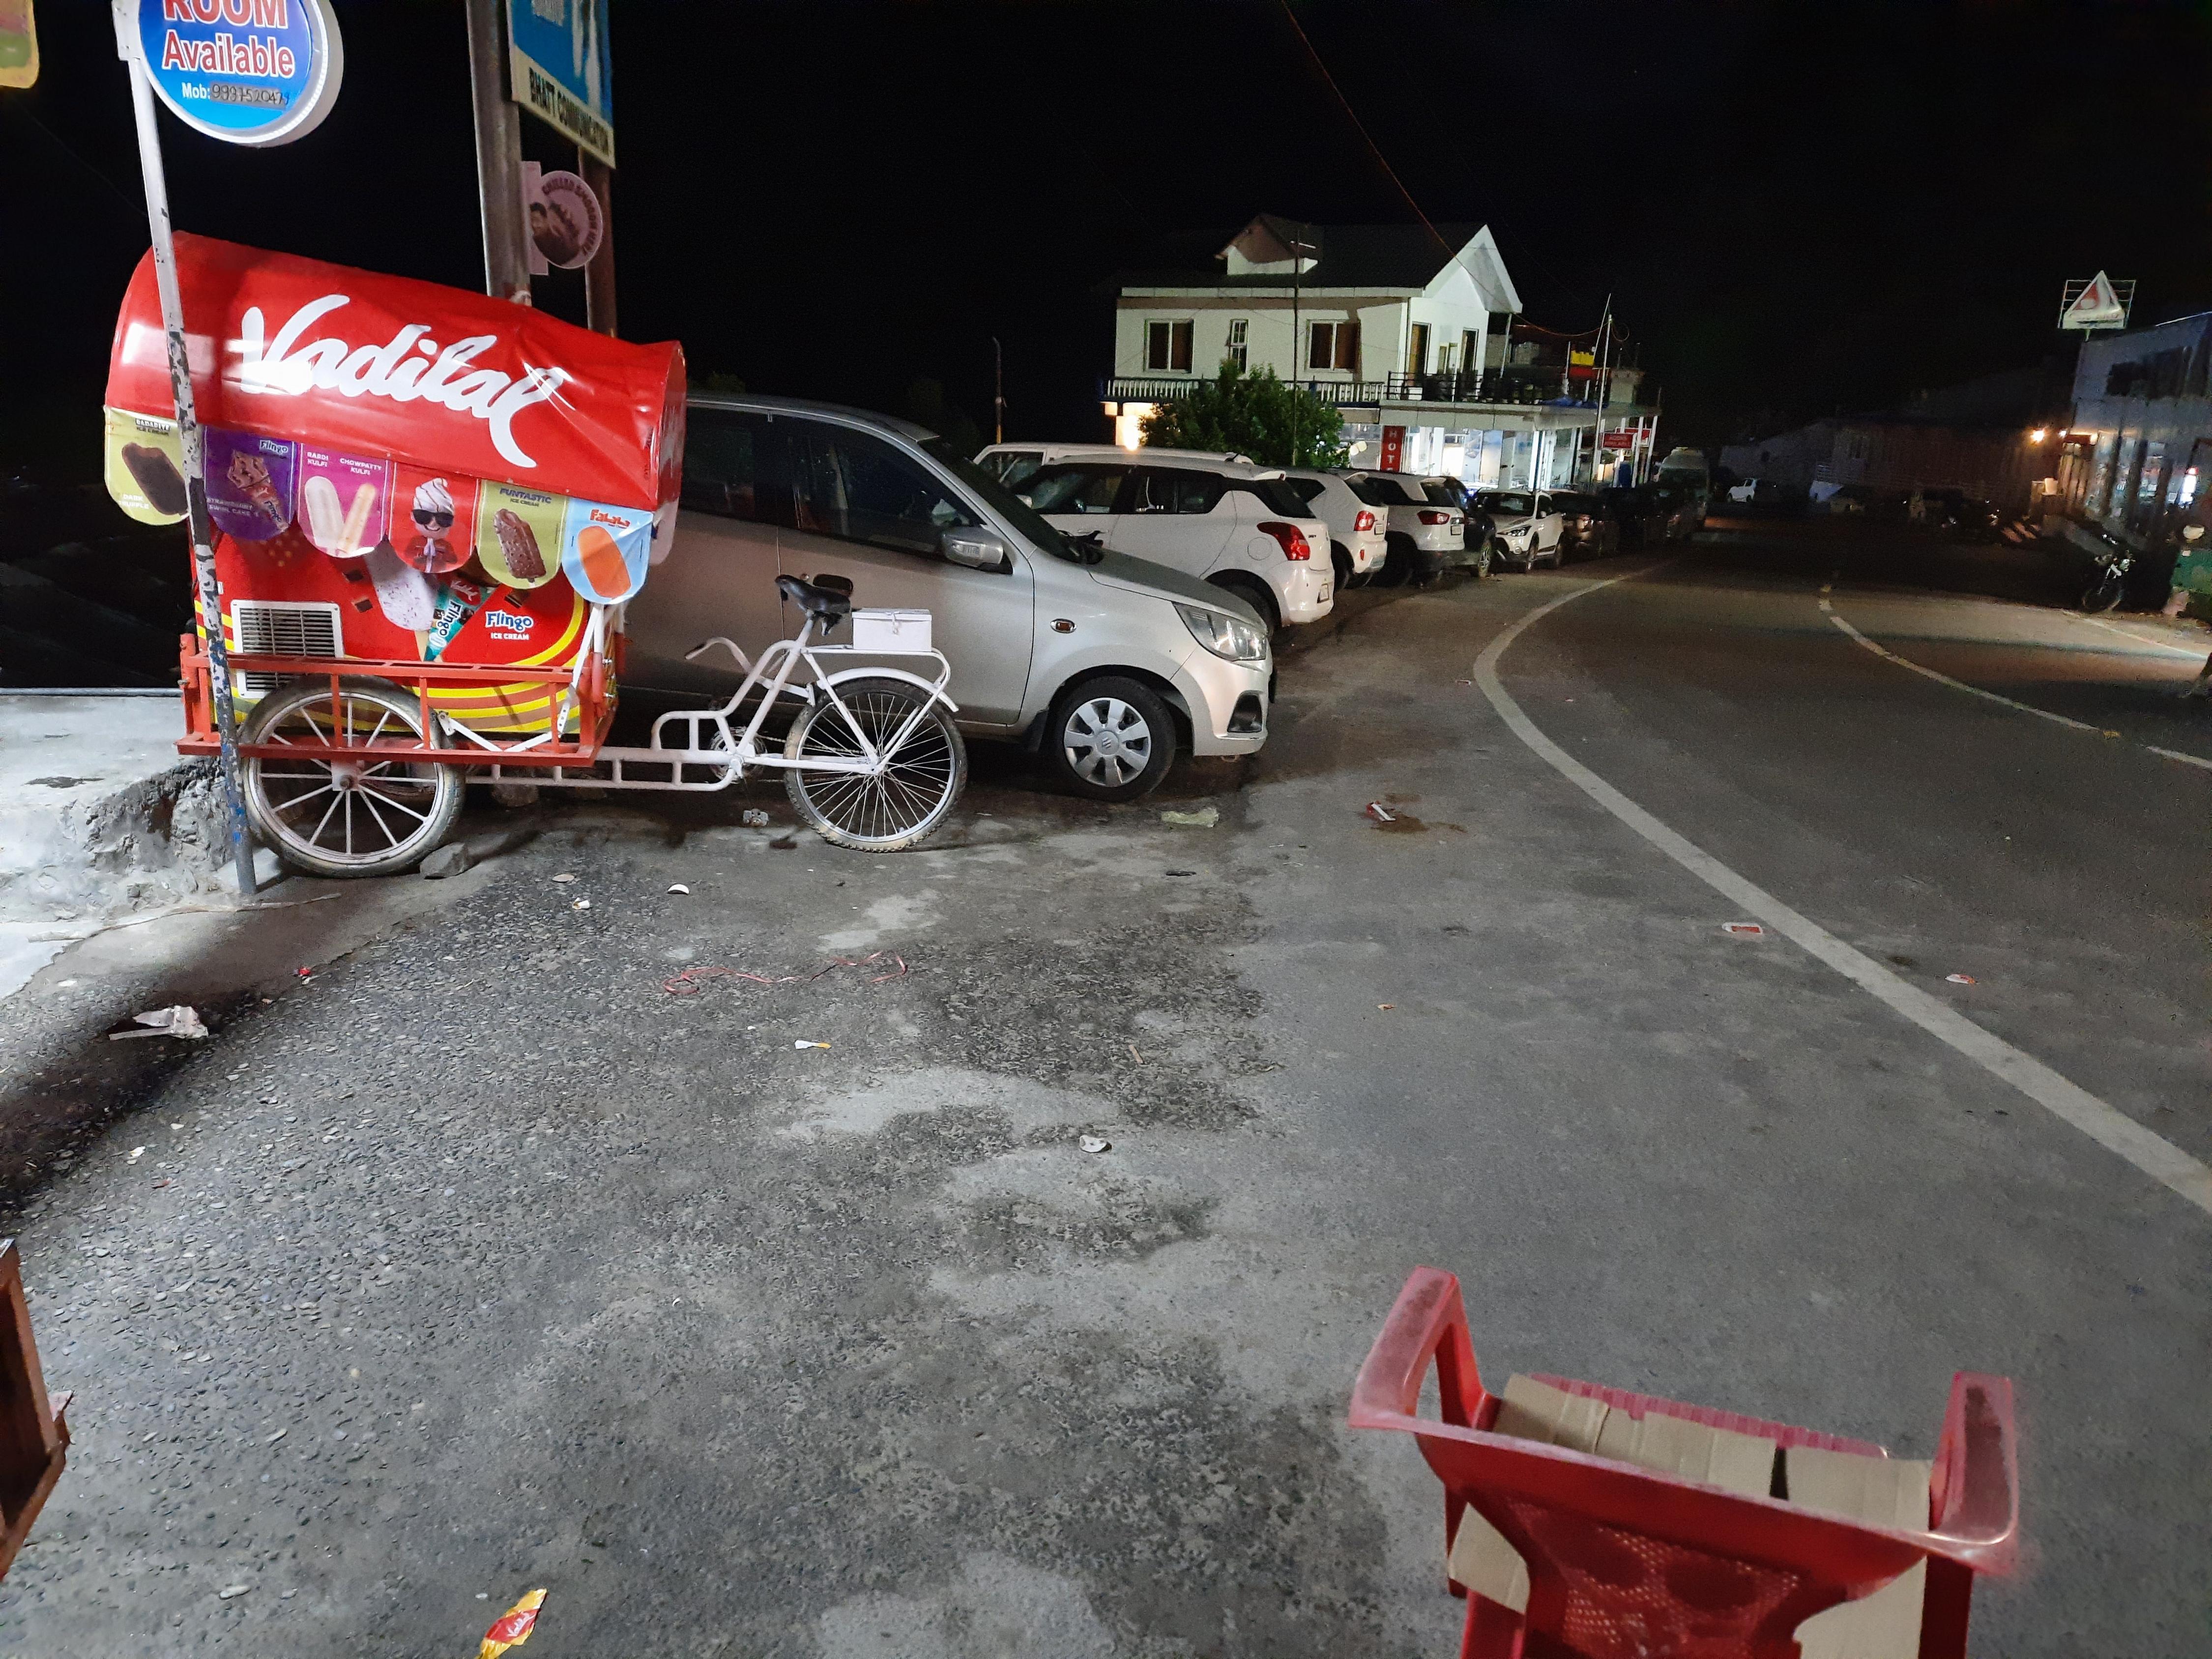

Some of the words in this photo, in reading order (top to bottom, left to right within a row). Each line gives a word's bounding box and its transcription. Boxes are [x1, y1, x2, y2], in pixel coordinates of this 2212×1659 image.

[162, 29, 295, 79] Available
[181, 82, 210, 100] Mob:
[240, 294, 571, 468] Vadilal
[260, 439, 289, 455] Flingo
[340, 458, 382, 470] CHOWPATTY
[499, 488, 552, 504] FUNTASTIC
[435, 600, 463, 637] Flingo
[485, 610, 534, 633] Flingo
